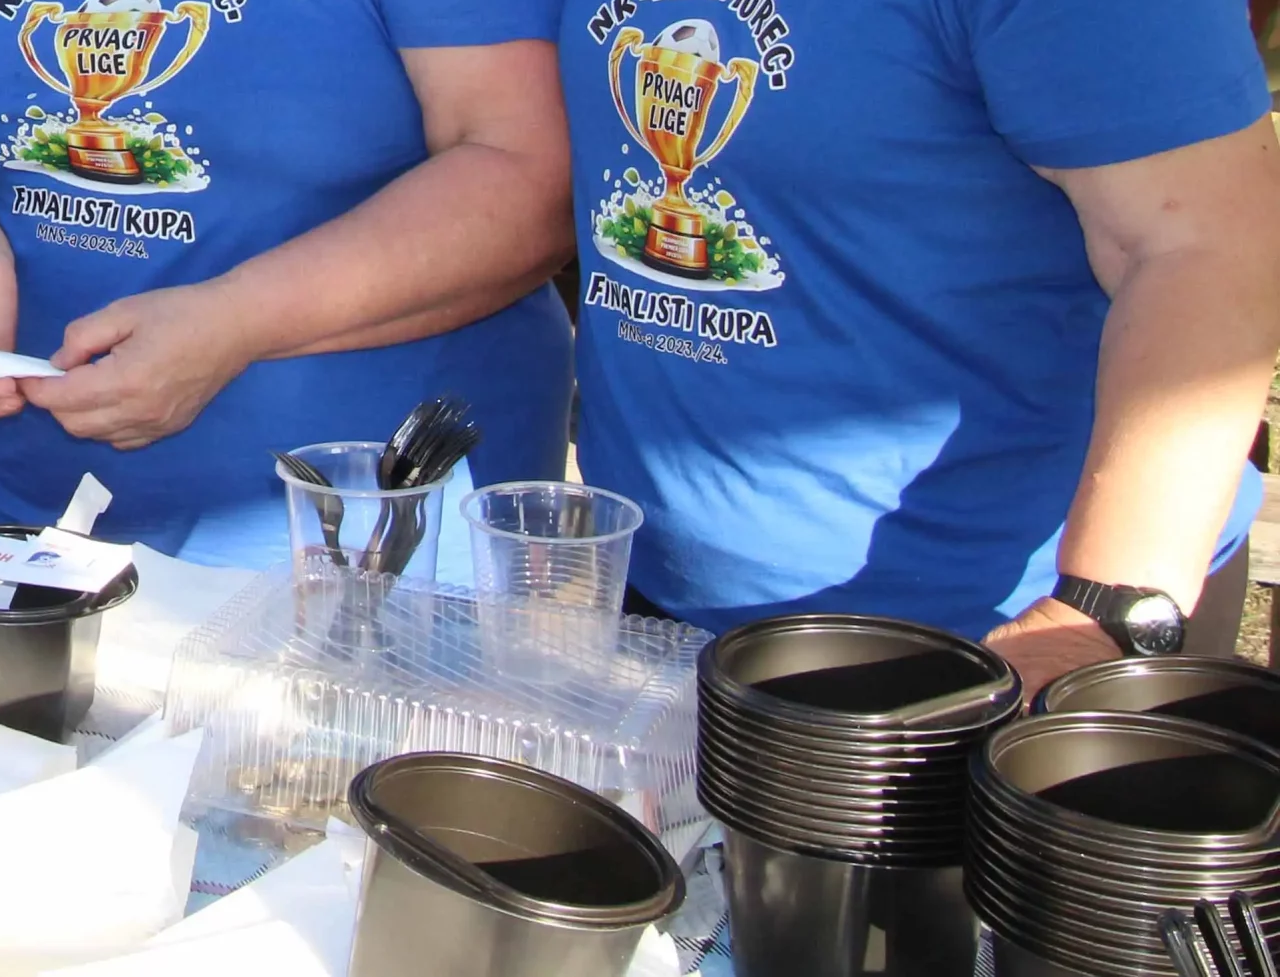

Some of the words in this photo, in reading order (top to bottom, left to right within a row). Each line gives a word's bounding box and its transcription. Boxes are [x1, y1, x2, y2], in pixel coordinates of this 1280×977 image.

[62, 28, 146, 51] PRVACI
[77, 53, 127, 75] LIGE
[642, 72, 702, 112] PRVACI
[648, 104, 687, 136] LIGE
[13, 186, 120, 230] FINALISTI
[125, 206, 195, 243] KUPA
[36, 223, 77, 246] MNS-a
[586, 272, 694, 331] FINALISTI
[699, 304, 777, 347] KUPA
